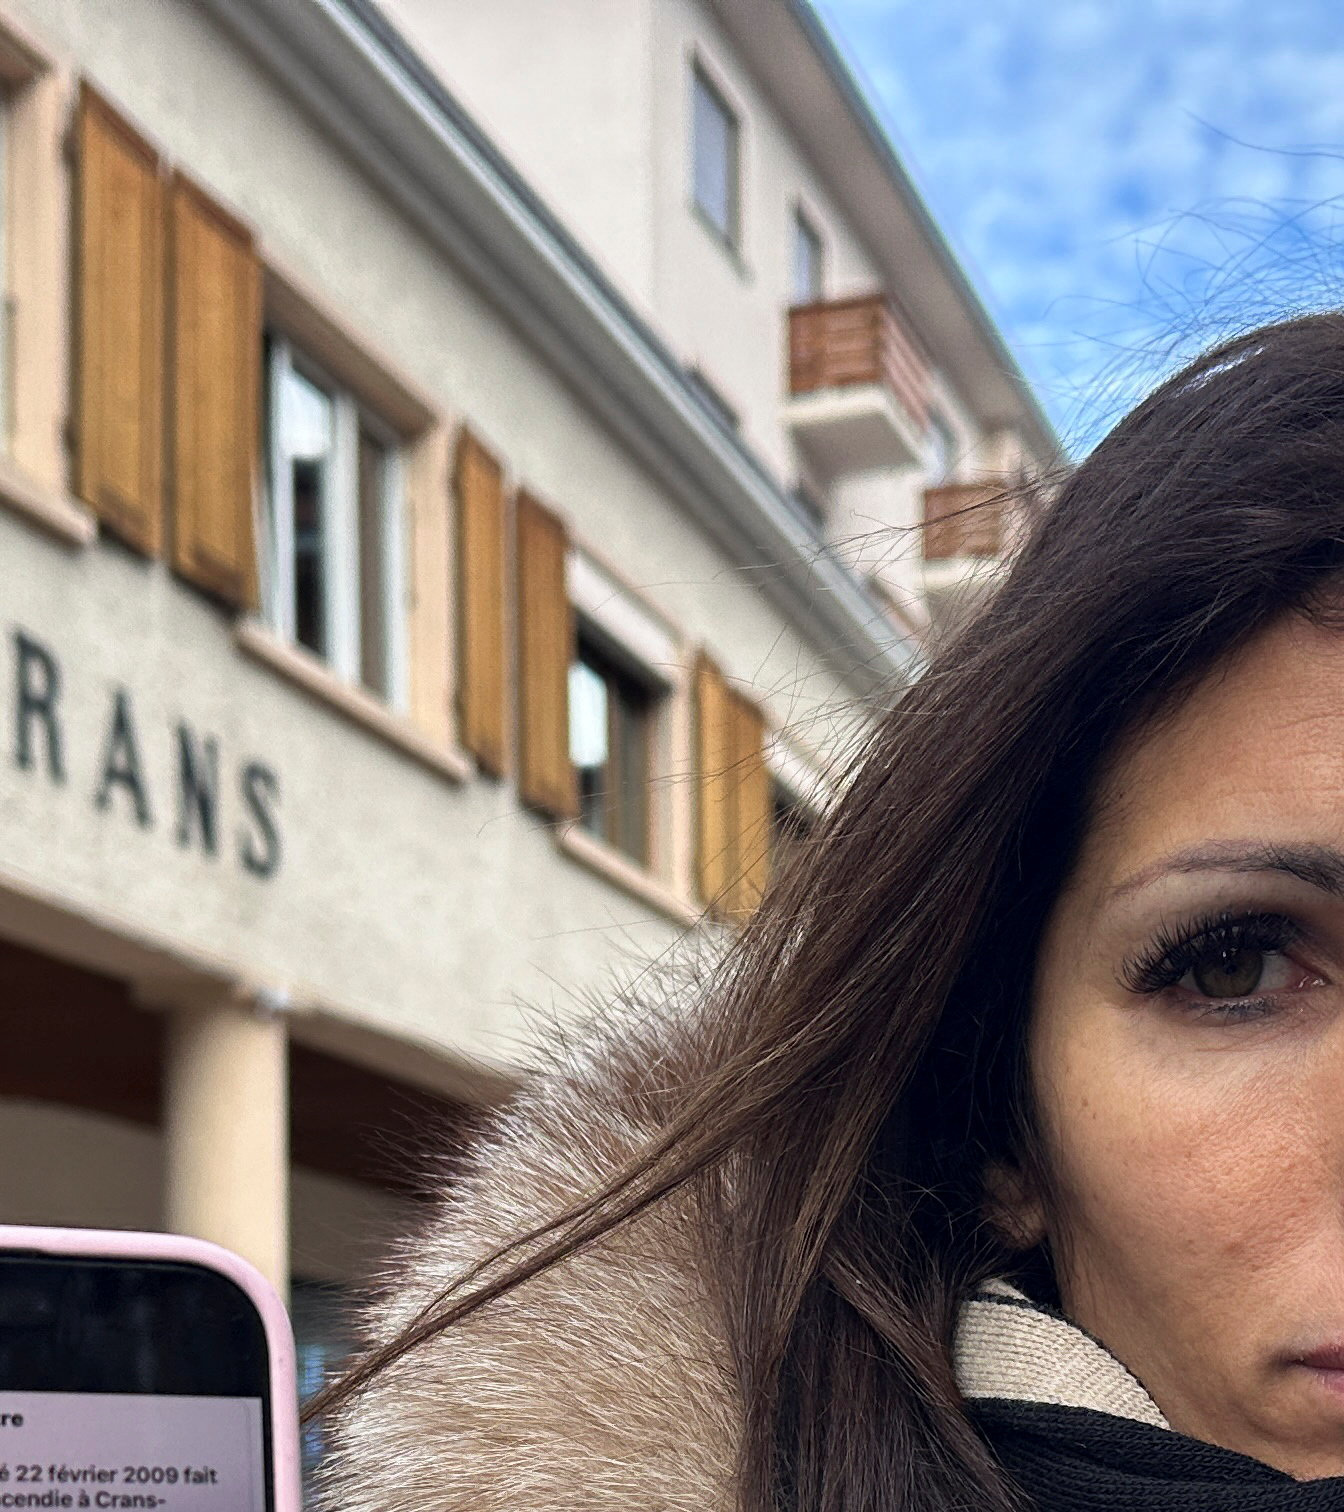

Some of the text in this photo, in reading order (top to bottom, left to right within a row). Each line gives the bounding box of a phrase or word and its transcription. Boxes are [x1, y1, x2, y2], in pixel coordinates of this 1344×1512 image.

[15, 1464, 44, 1482] 22
[48, 1464, 118, 1483] février
[123, 1466, 179, 1484] 2009
[183, 1465, 218, 1484] fait
[78, 1489, 91, 1508] à
[95, 1490, 167, 1509] Crans-
